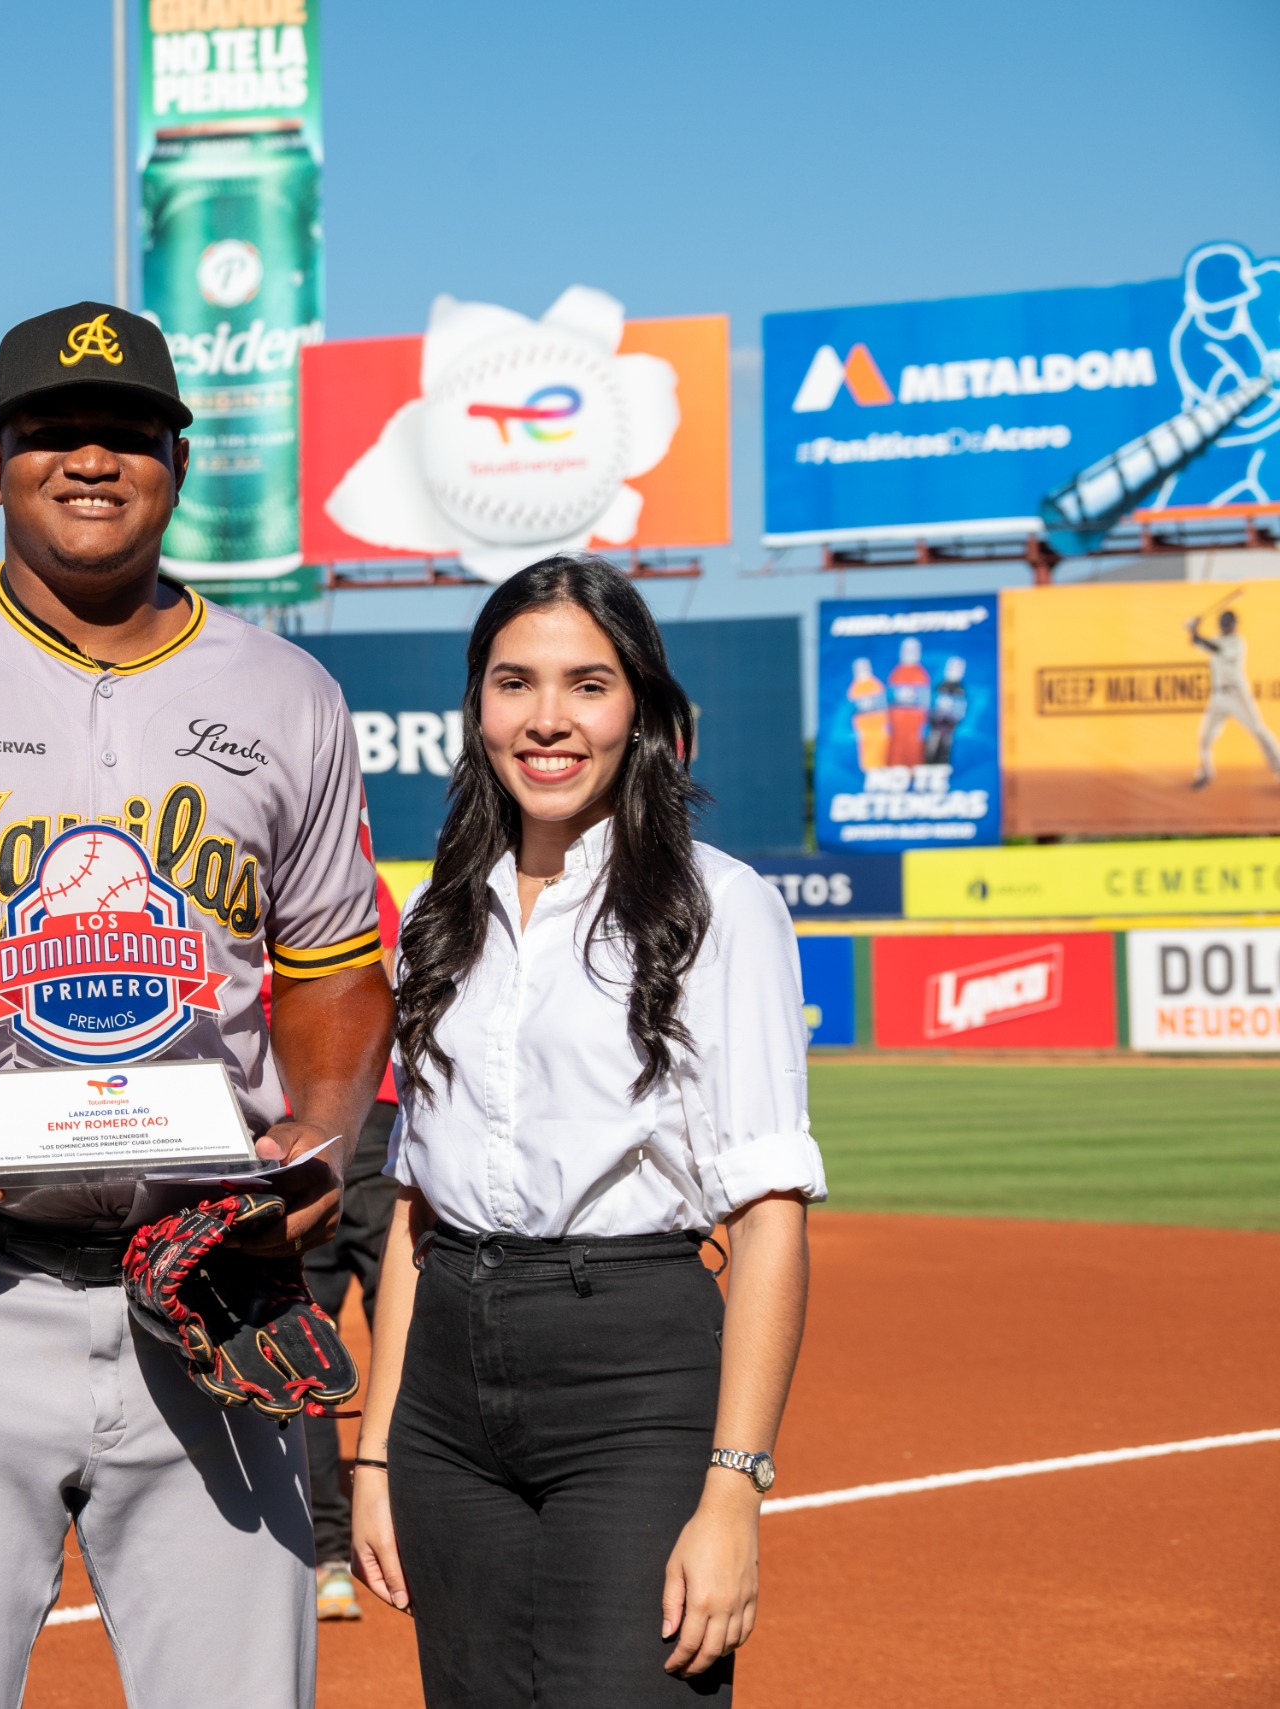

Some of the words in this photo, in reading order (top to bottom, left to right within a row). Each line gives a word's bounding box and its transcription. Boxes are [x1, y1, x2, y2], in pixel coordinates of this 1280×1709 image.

[150, 0, 308, 33] GRANDE
[153, 31, 210, 74] NO
[211, 28, 258, 71] TE
[258, 26, 308, 68] LA
[153, 66, 309, 115] PIERDAS
[897, 347, 1157, 404] METALDOM
[796, 424, 1072, 465] #FanáticosDeAcero
[1045, 676, 1096, 706] KEEP
[174, 718, 270, 777] Linda
[863, 764, 911, 793] NO
[912, 763, 953, 793] TE
[830, 790, 989, 822] DETENGAS
[75, 913, 119, 931] LOS
[0, 931, 199, 984] DOMINICANOS
[1157, 942, 1280, 997] DOL
[42, 979, 164, 1003] PRIMERO
[68, 1011, 136, 1030] PREMIOS
[1156, 1005, 1280, 1038] NEURO
[47, 1120, 81, 1131] ENNY
[85, 1117, 138, 1129] ROMERO
[141, 1116, 169, 1127] (AC)
[68, 1109, 113, 1118] LANZADOR
[115, 1108, 130, 1116] DEL
[132, 1106, 150, 1115] AÑO
[100, 1133, 149, 1141] TOTALENERGIES
[152, 1137, 183, 1145] CÓRDOVA
